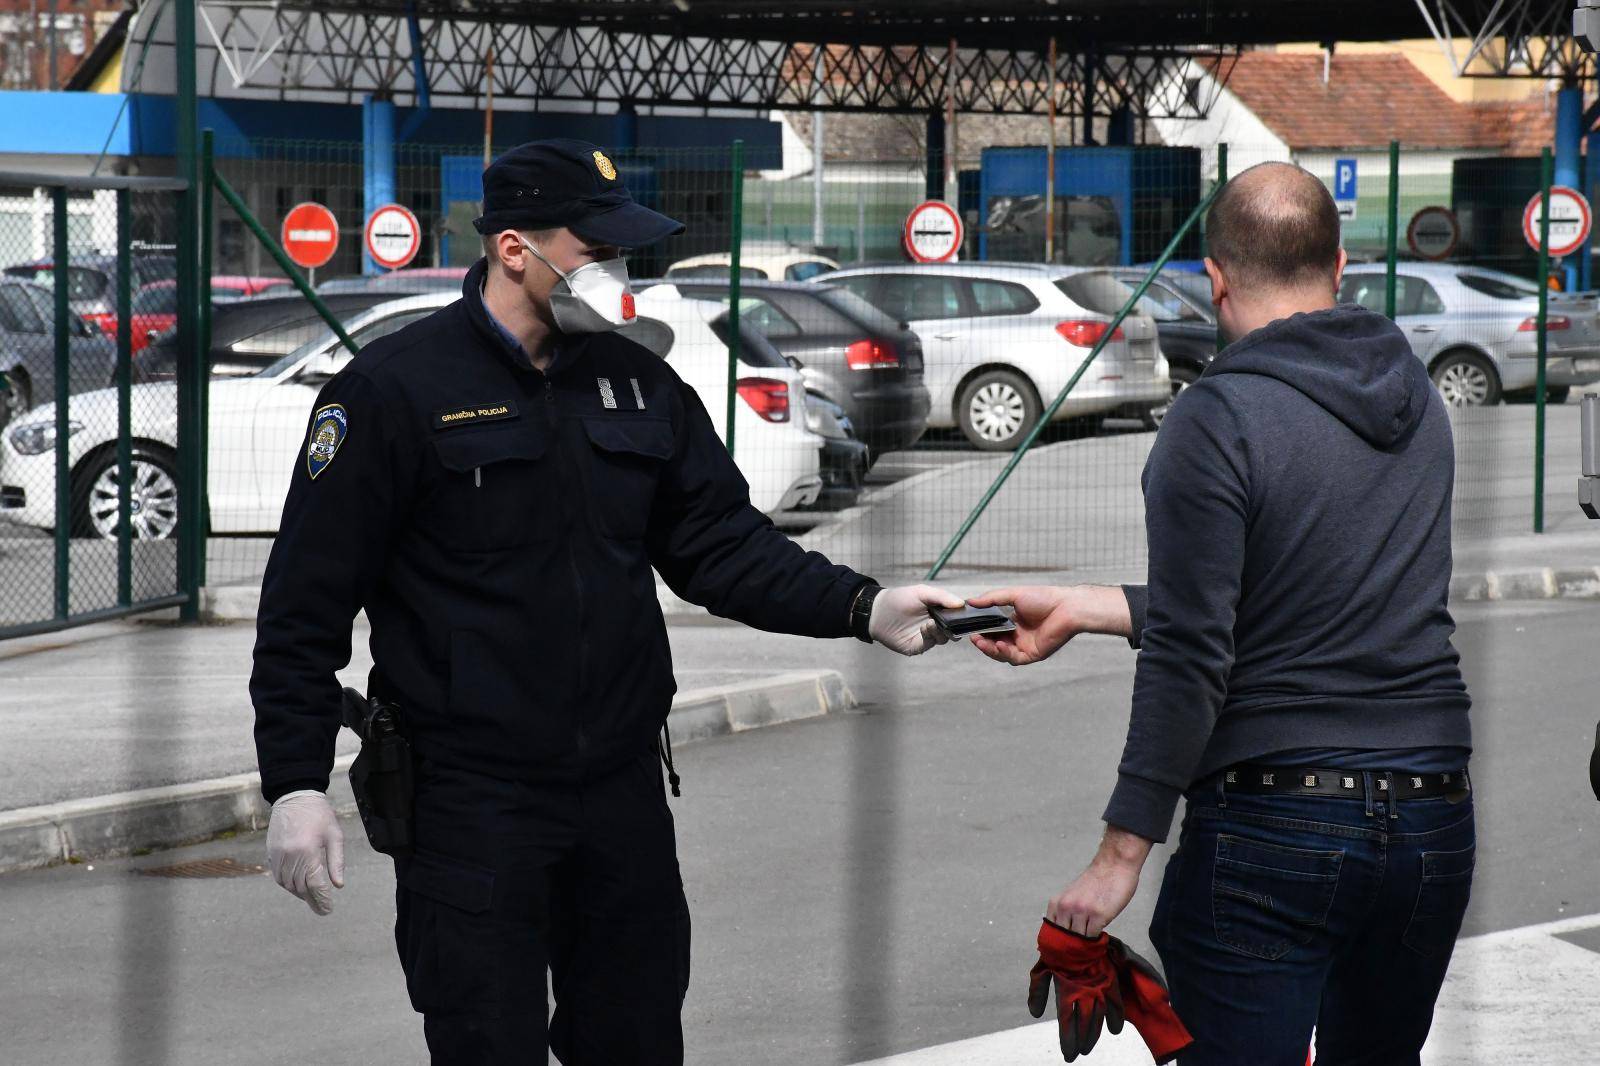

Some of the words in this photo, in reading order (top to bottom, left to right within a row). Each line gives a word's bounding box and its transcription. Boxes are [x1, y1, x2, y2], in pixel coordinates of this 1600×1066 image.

[1340, 165, 1353, 194] P
[441, 410, 477, 422] GRANIČNA
[477, 406, 508, 416] POLICIJA
